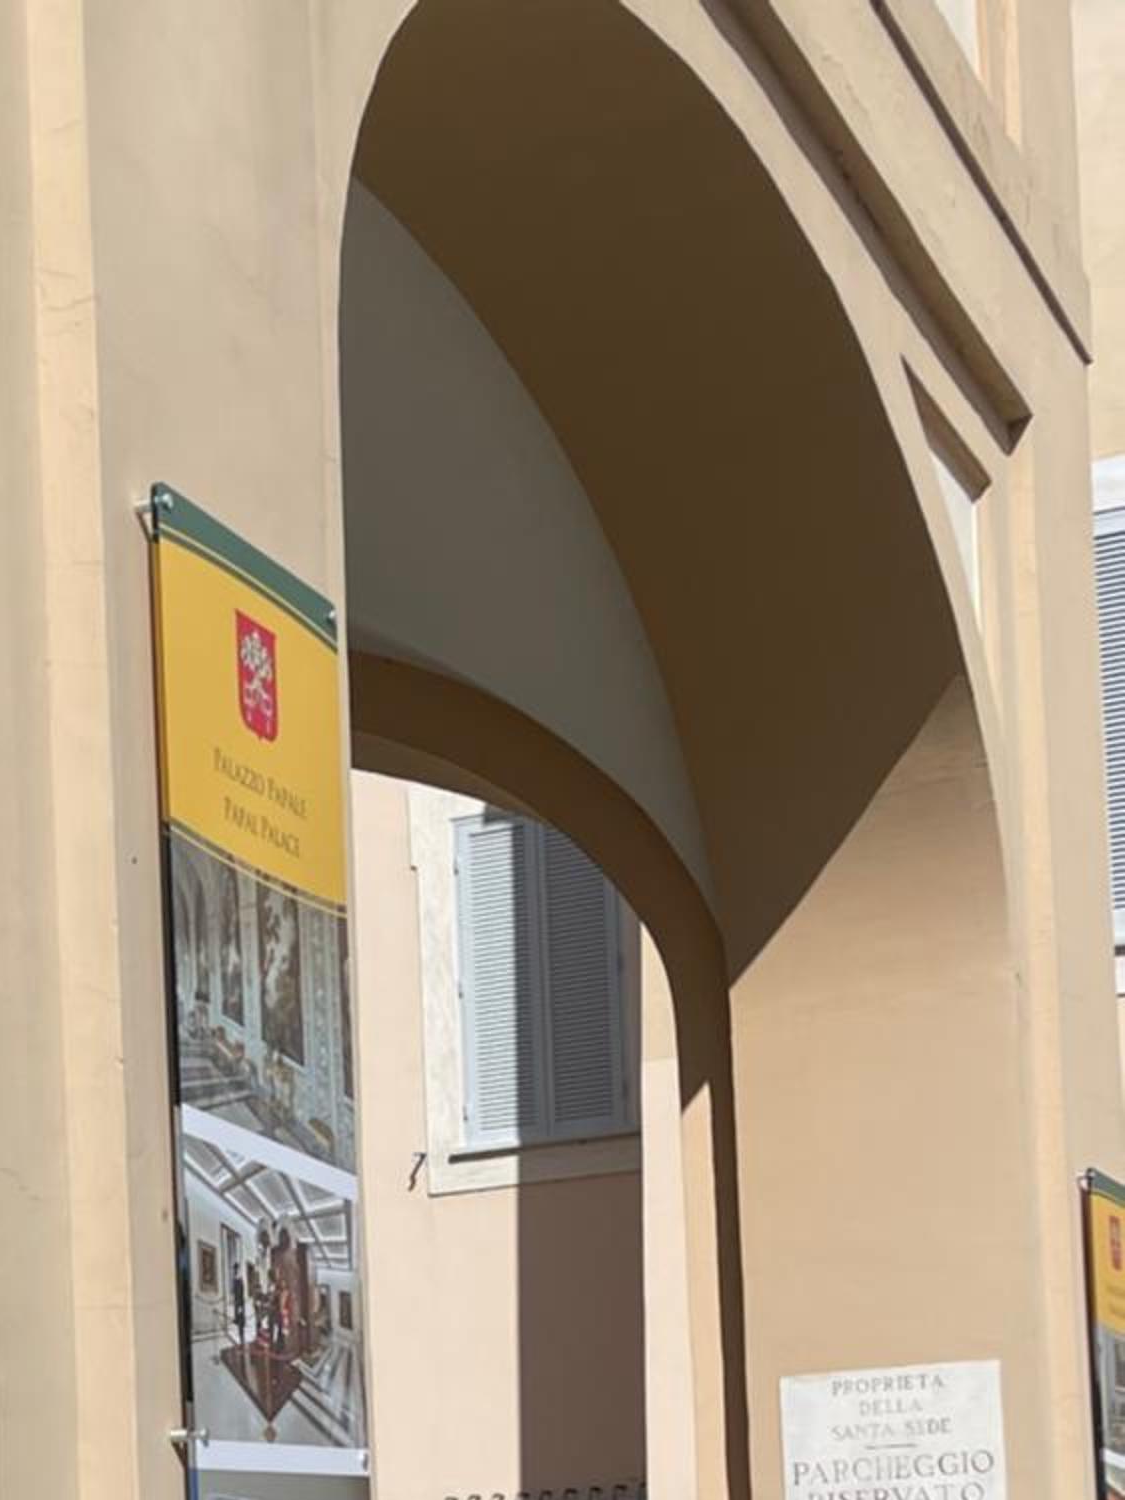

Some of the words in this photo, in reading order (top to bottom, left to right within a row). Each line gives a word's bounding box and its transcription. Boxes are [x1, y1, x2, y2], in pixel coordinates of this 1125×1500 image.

[859, 1397, 923, 1417] DELLA
[831, 1422, 896, 1441] SANTA
[905, 1418, 952, 1437] SIDE
[793, 1449, 995, 1486] PARCHEGGIO
